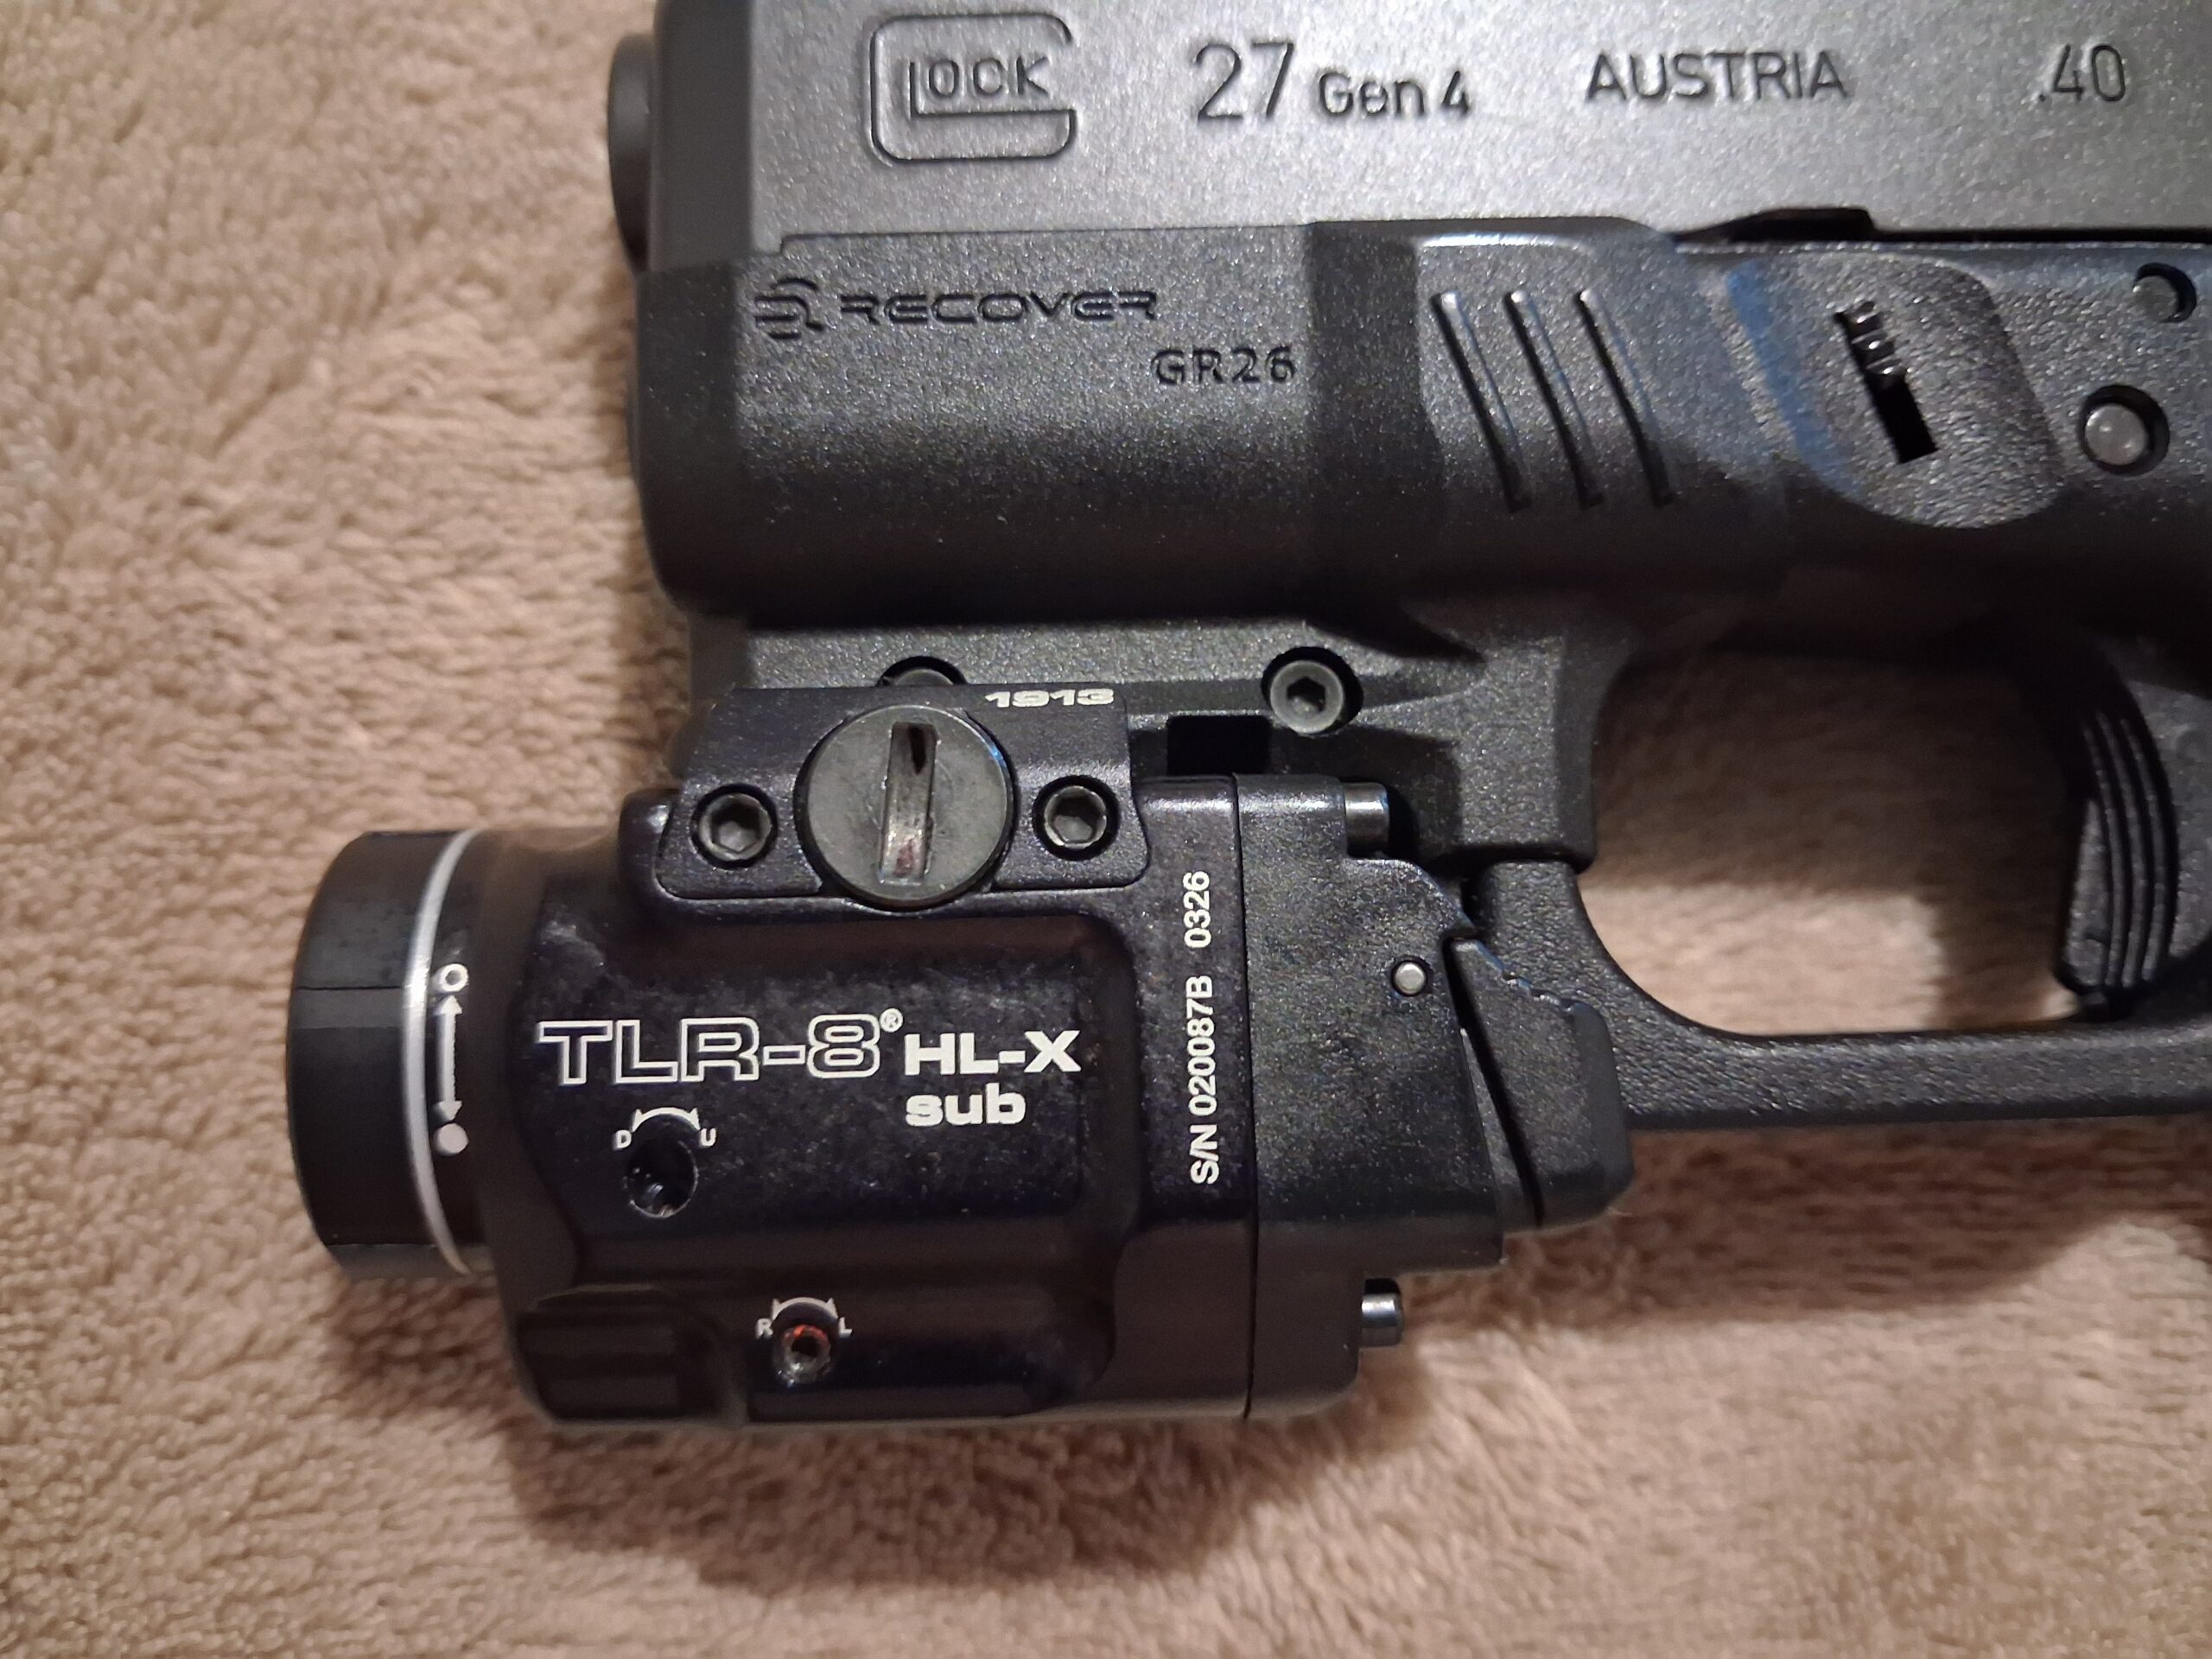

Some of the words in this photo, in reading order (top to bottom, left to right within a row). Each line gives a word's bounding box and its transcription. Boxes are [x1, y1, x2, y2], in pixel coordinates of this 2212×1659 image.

[868, 12, 1077, 163] GLOCK
[1193, 40, 1295, 123] 27
[1585, 50, 1847, 101] AUSTRIA
[2037, 43, 2126, 104] .40
[839, 289, 1158, 325] RECOVER
[1153, 346, 1296, 386] GR26
[985, 688, 1115, 709] 1913
[1183, 870, 1212, 949] 0326
[904, 1030, 1082, 1077] HL-X
[1185, 974, 1217, 1117] 020087B
[905, 1083, 1027, 1126] sub
[613, 1129, 632, 1151] D
[699, 1128, 717, 1147] U
[1190, 1123, 1220, 1185] S/N
[756, 1318, 774, 1339] R
[839, 1316, 853, 1338] L
